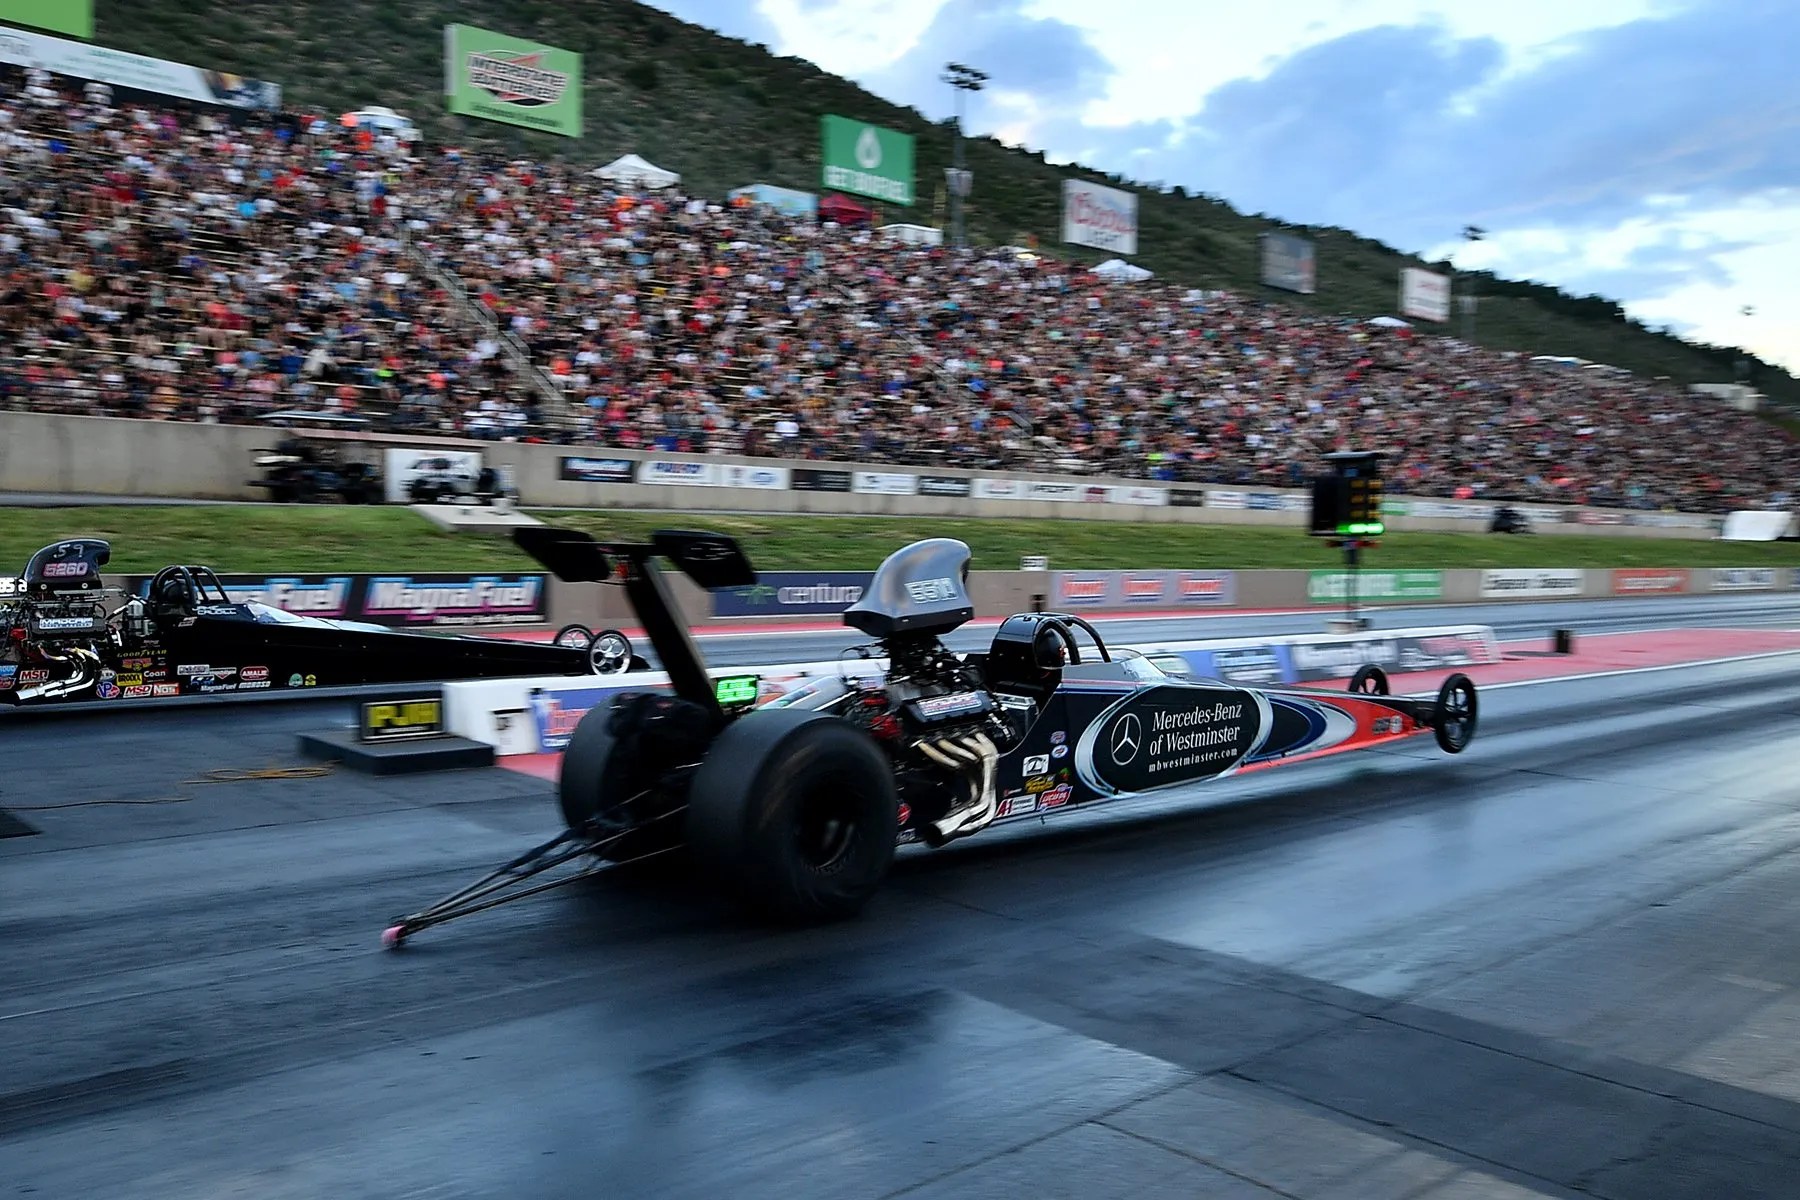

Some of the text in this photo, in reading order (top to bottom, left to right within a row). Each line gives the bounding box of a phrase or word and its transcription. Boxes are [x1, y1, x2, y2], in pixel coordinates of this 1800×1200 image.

[43, 562, 89, 578] 5260
[366, 577, 542, 617] MagnaFuel
[116, 649, 168, 658] GOODYEAR
[143, 670, 166, 678] Coan
[97, 682, 113, 698] VP
[126, 685, 151, 694] MSD
[1152, 702, 1243, 732] Mercedes-Benz
[1150, 725, 1241, 756] of Westminster
[1148, 746, 1238, 773] mbwestminster.com
